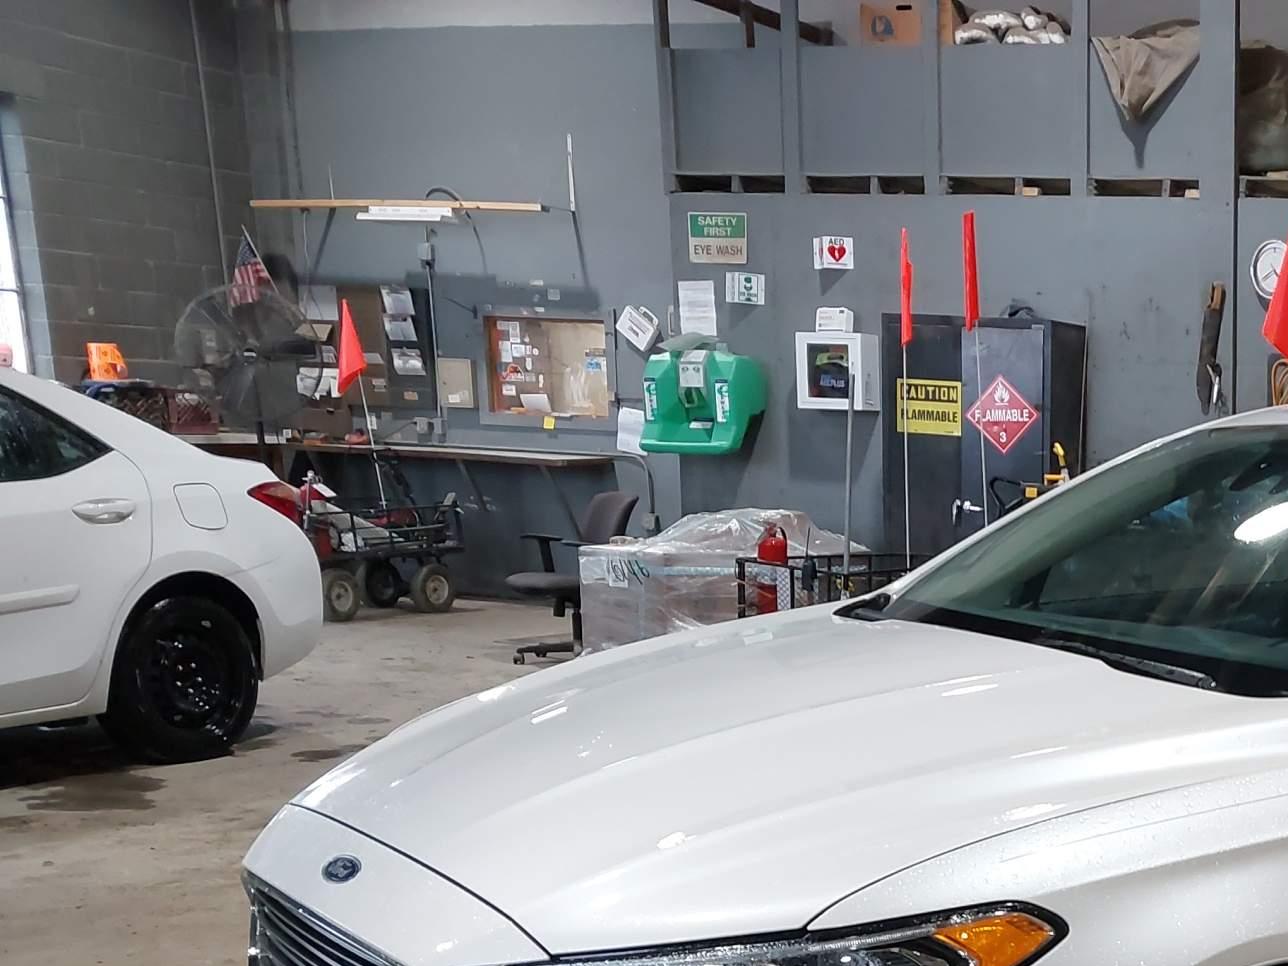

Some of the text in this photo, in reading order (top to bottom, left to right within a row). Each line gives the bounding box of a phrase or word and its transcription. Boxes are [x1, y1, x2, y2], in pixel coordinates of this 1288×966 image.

[697, 216, 737, 226] SAFETY
[703, 227, 732, 237] FIRST
[828, 238, 845, 246] AED
[693, 244, 743, 256] EYE WASH
[901, 385, 958, 401] CAUTION
[999, 431, 1007, 443] 3
